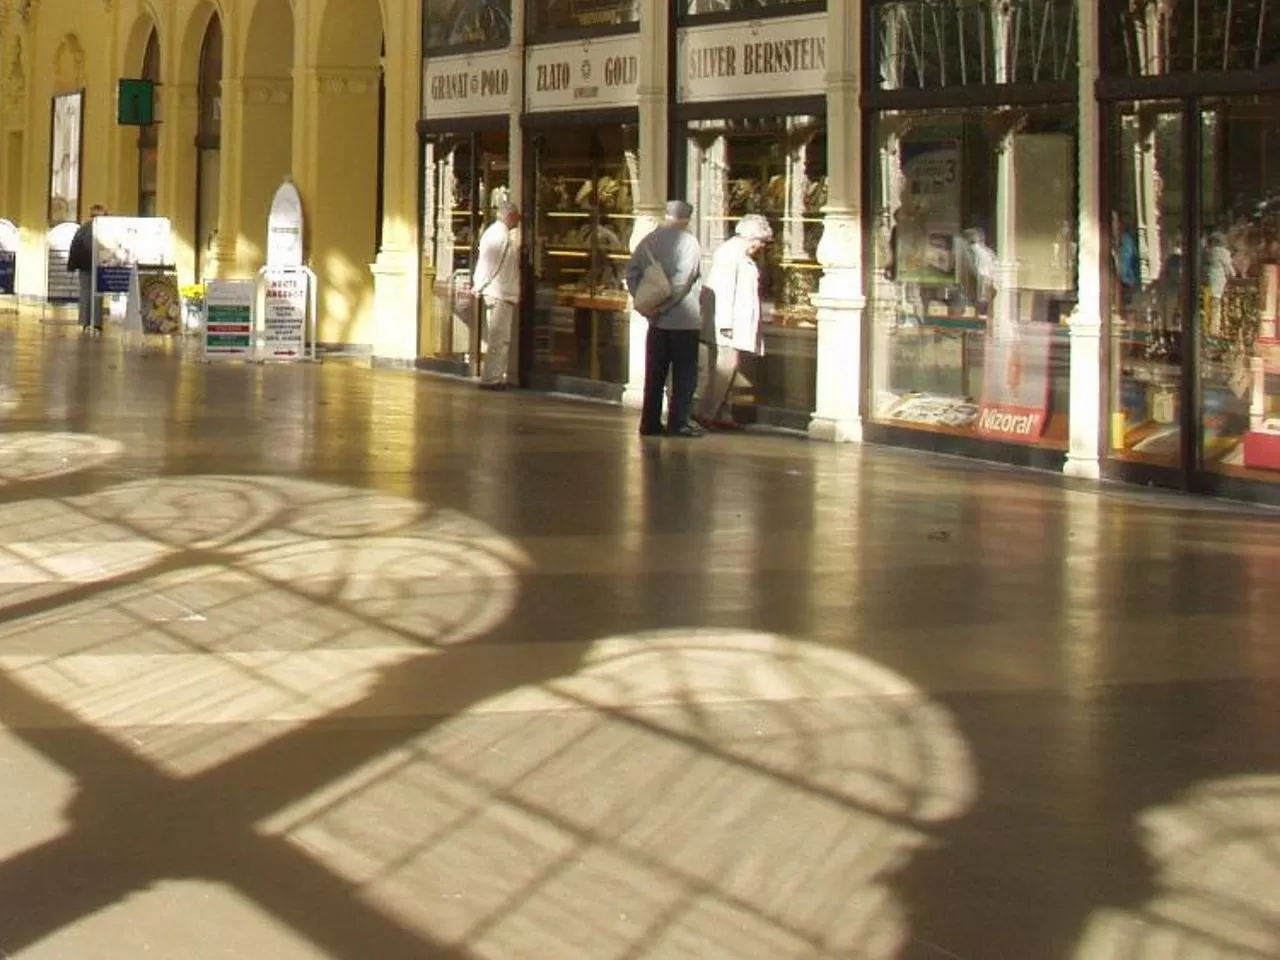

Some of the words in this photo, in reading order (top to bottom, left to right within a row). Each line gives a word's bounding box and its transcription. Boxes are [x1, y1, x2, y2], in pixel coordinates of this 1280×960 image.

[536, 61, 570, 92] ZLATO
[605, 55, 637, 87] GOLD
[689, 45, 736, 80] SILVER
[744, 36, 826, 75] BERNSTEIN
[481, 69, 508, 97] POLO
[979, 408, 1034, 434] Nizoral
